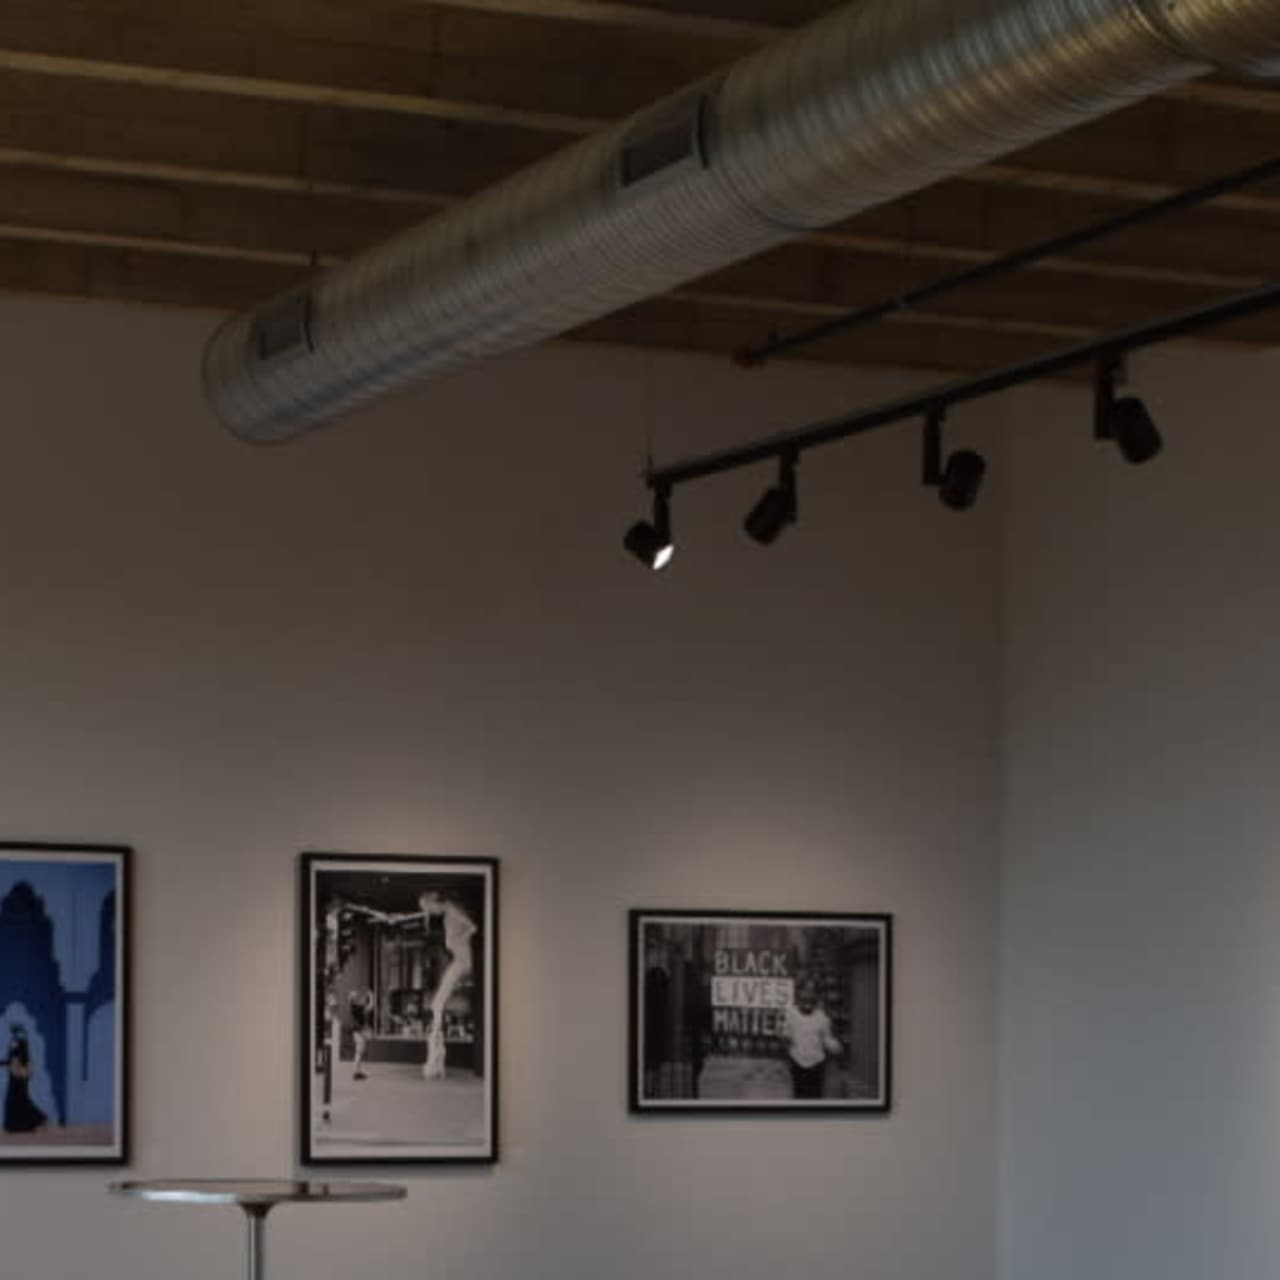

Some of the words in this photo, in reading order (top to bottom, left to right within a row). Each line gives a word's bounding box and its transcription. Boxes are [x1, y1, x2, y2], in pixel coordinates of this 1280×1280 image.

[714, 950, 788, 975] BLACK
[715, 980, 789, 1005] LIVES
[713, 1009, 789, 1035] MATTER
